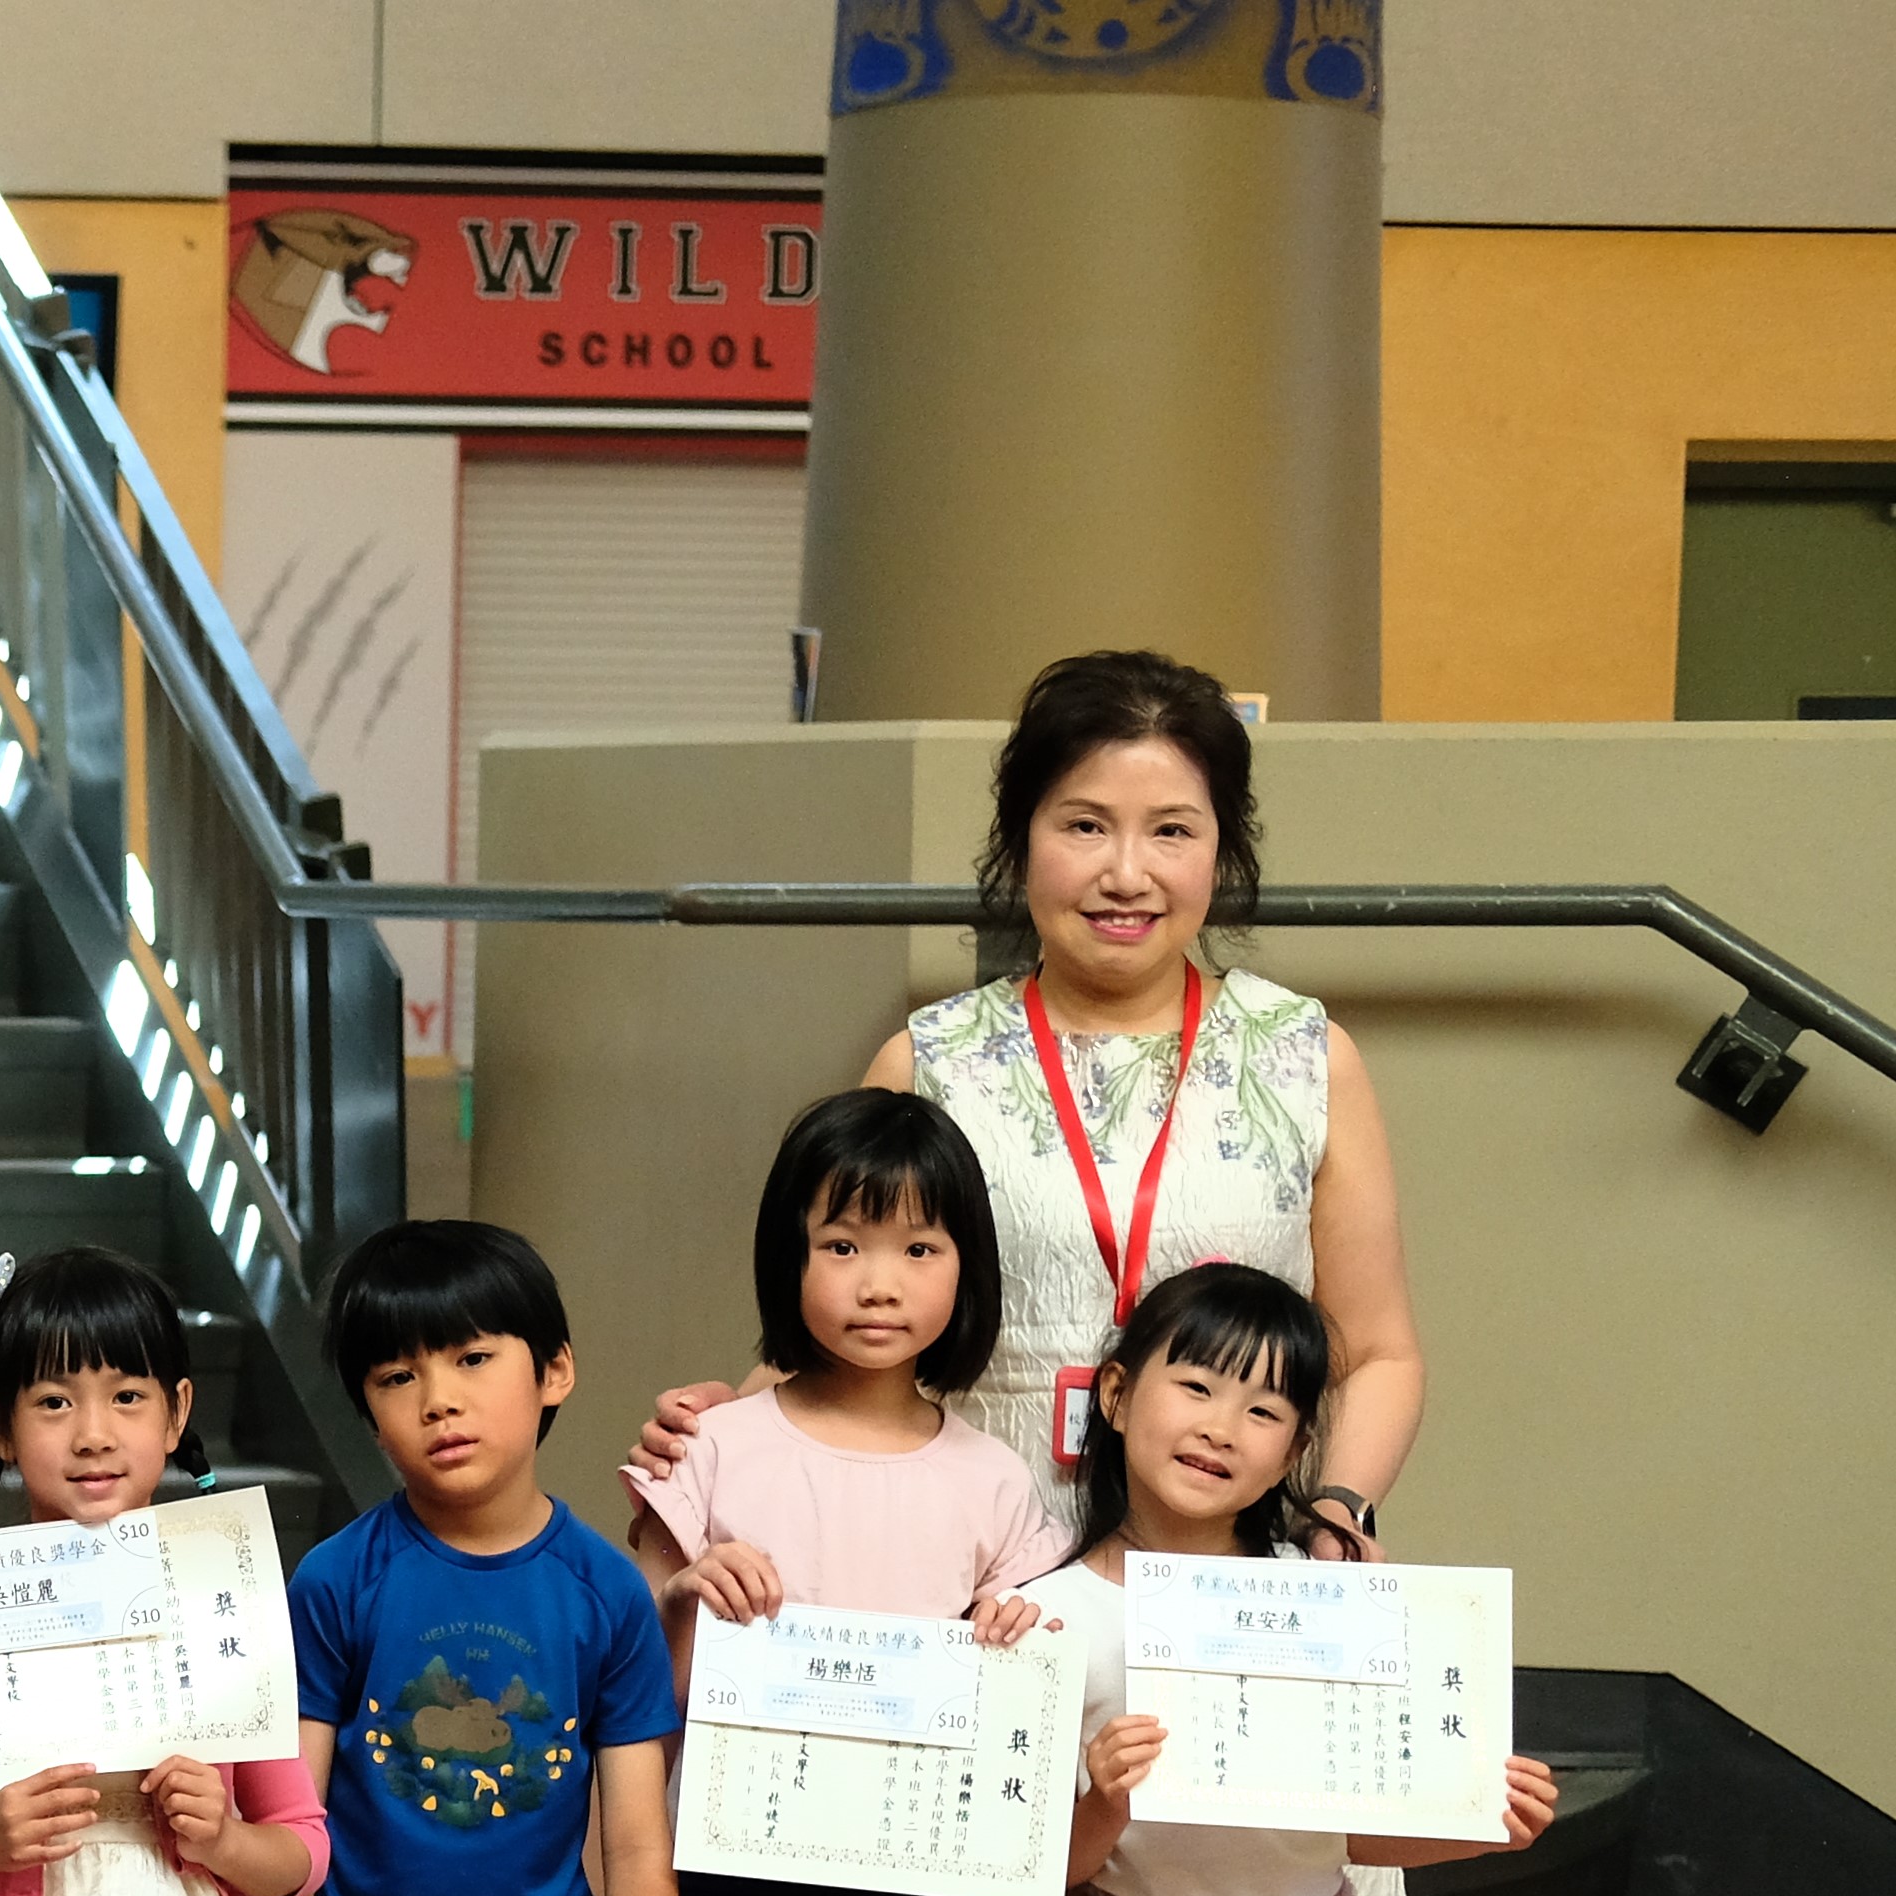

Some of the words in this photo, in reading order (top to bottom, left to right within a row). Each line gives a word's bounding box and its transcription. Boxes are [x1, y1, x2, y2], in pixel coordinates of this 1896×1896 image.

[539, 332, 775, 370] SCHOOL
[118, 1522, 149, 1539] $10
[1142, 1562, 1171, 1578] $10
[1191, 1574, 1346, 1599] 學業成績優良獎學金
[1368, 1577, 1397, 1593] $10
[130, 1608, 160, 1625] $10
[214, 1590, 247, 1659] 獎狀
[766, 1621, 924, 1650] 學業成績優良獎學金
[1142, 1643, 1171, 1659] $10
[1368, 1658, 1397, 1675] $10
[707, 1689, 736, 1706] $10
[1441, 1667, 1466, 1739] 獎狀
[937, 1712, 966, 1729] $10
[1002, 1728, 1030, 1803] 獎狀
